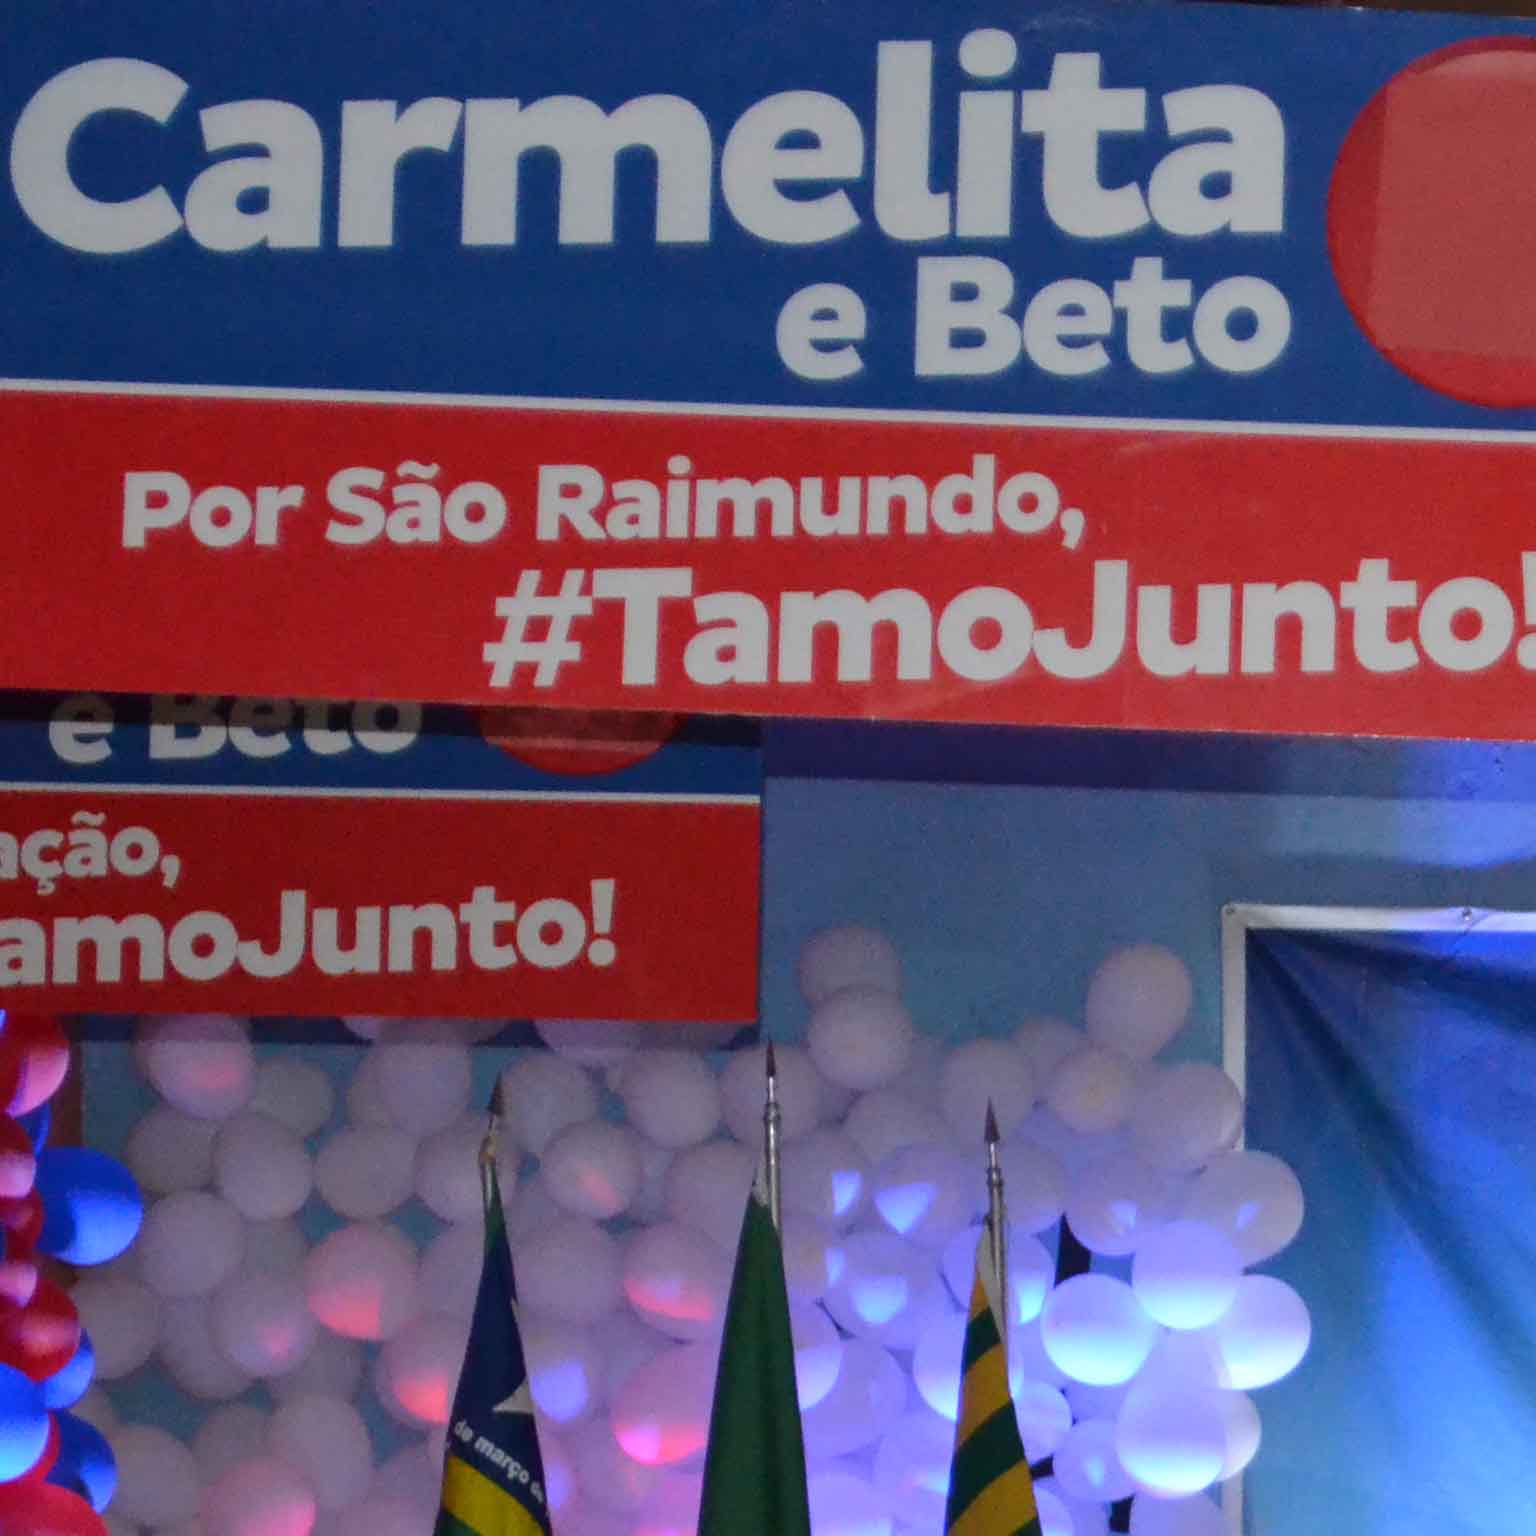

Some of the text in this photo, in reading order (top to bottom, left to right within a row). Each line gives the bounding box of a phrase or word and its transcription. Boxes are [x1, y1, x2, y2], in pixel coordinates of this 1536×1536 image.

[10, 28, 1286, 255] Carmelita
[775, 255, 1292, 381] e Beto
[122, 453, 1086, 551] Por São Raimundo,
